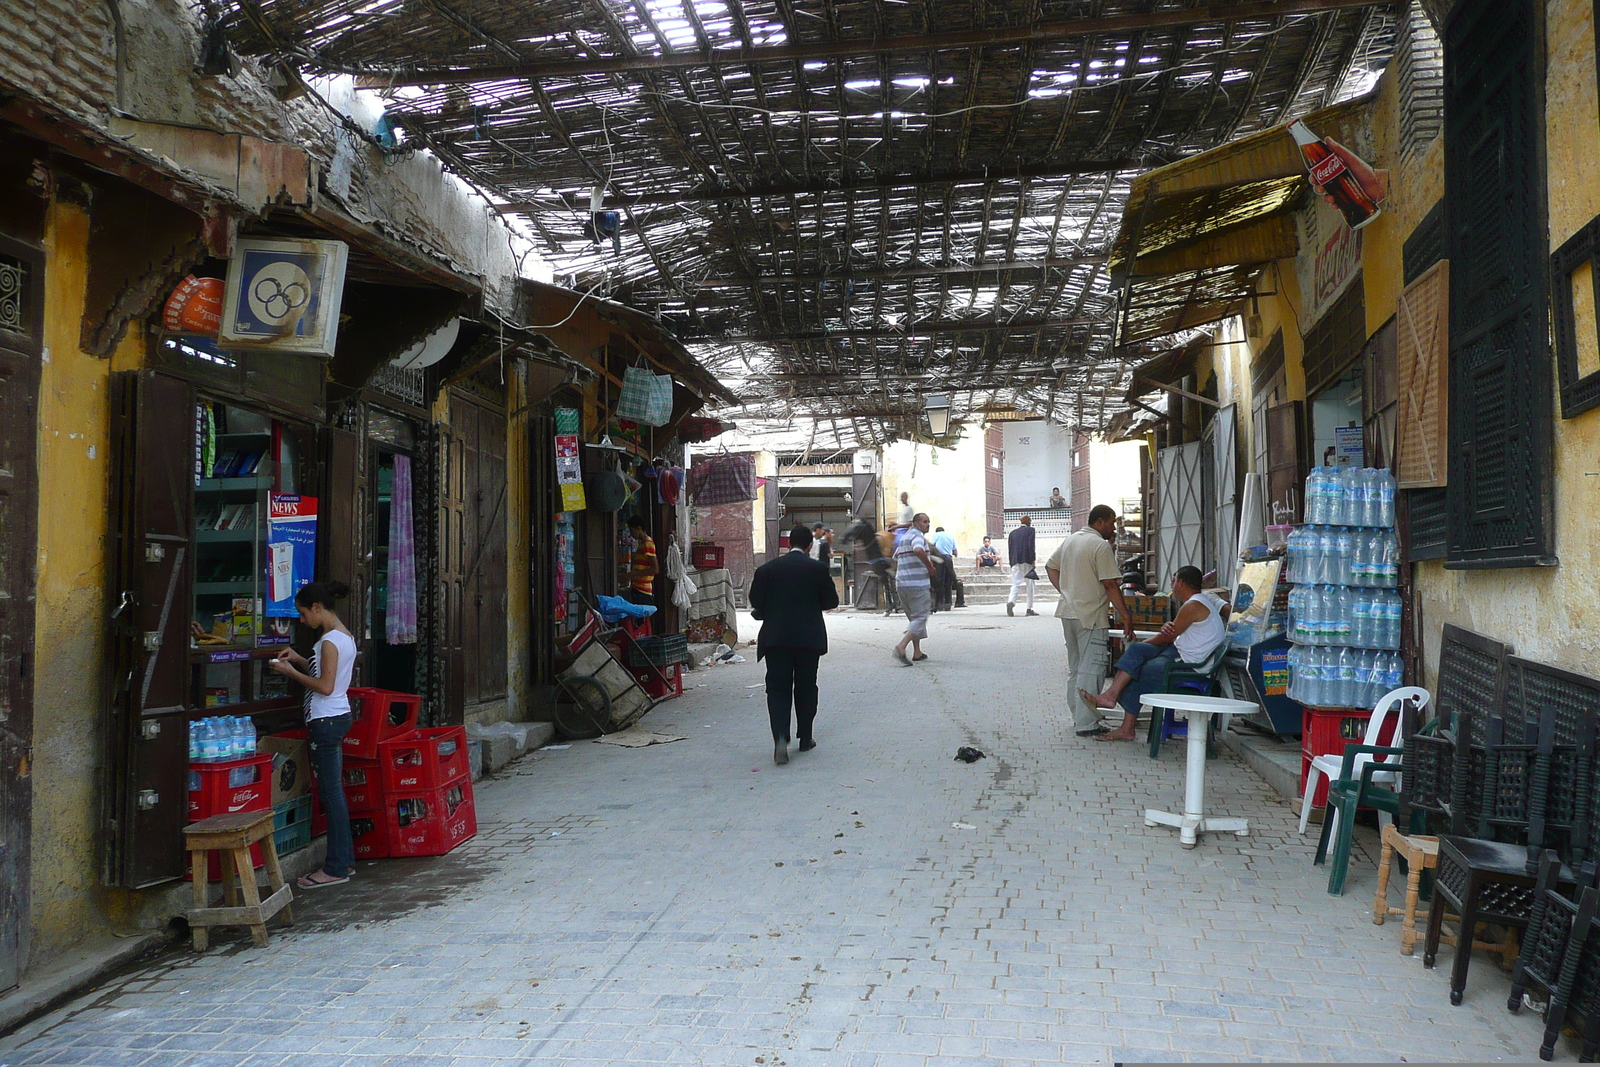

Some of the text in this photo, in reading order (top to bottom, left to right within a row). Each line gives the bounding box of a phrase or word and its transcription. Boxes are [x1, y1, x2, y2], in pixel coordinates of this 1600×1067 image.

[1316, 157, 1341, 181] Coca-Cola
[272, 500, 298, 515] NEWS
[232, 789, 252, 803] Coca-Cola
